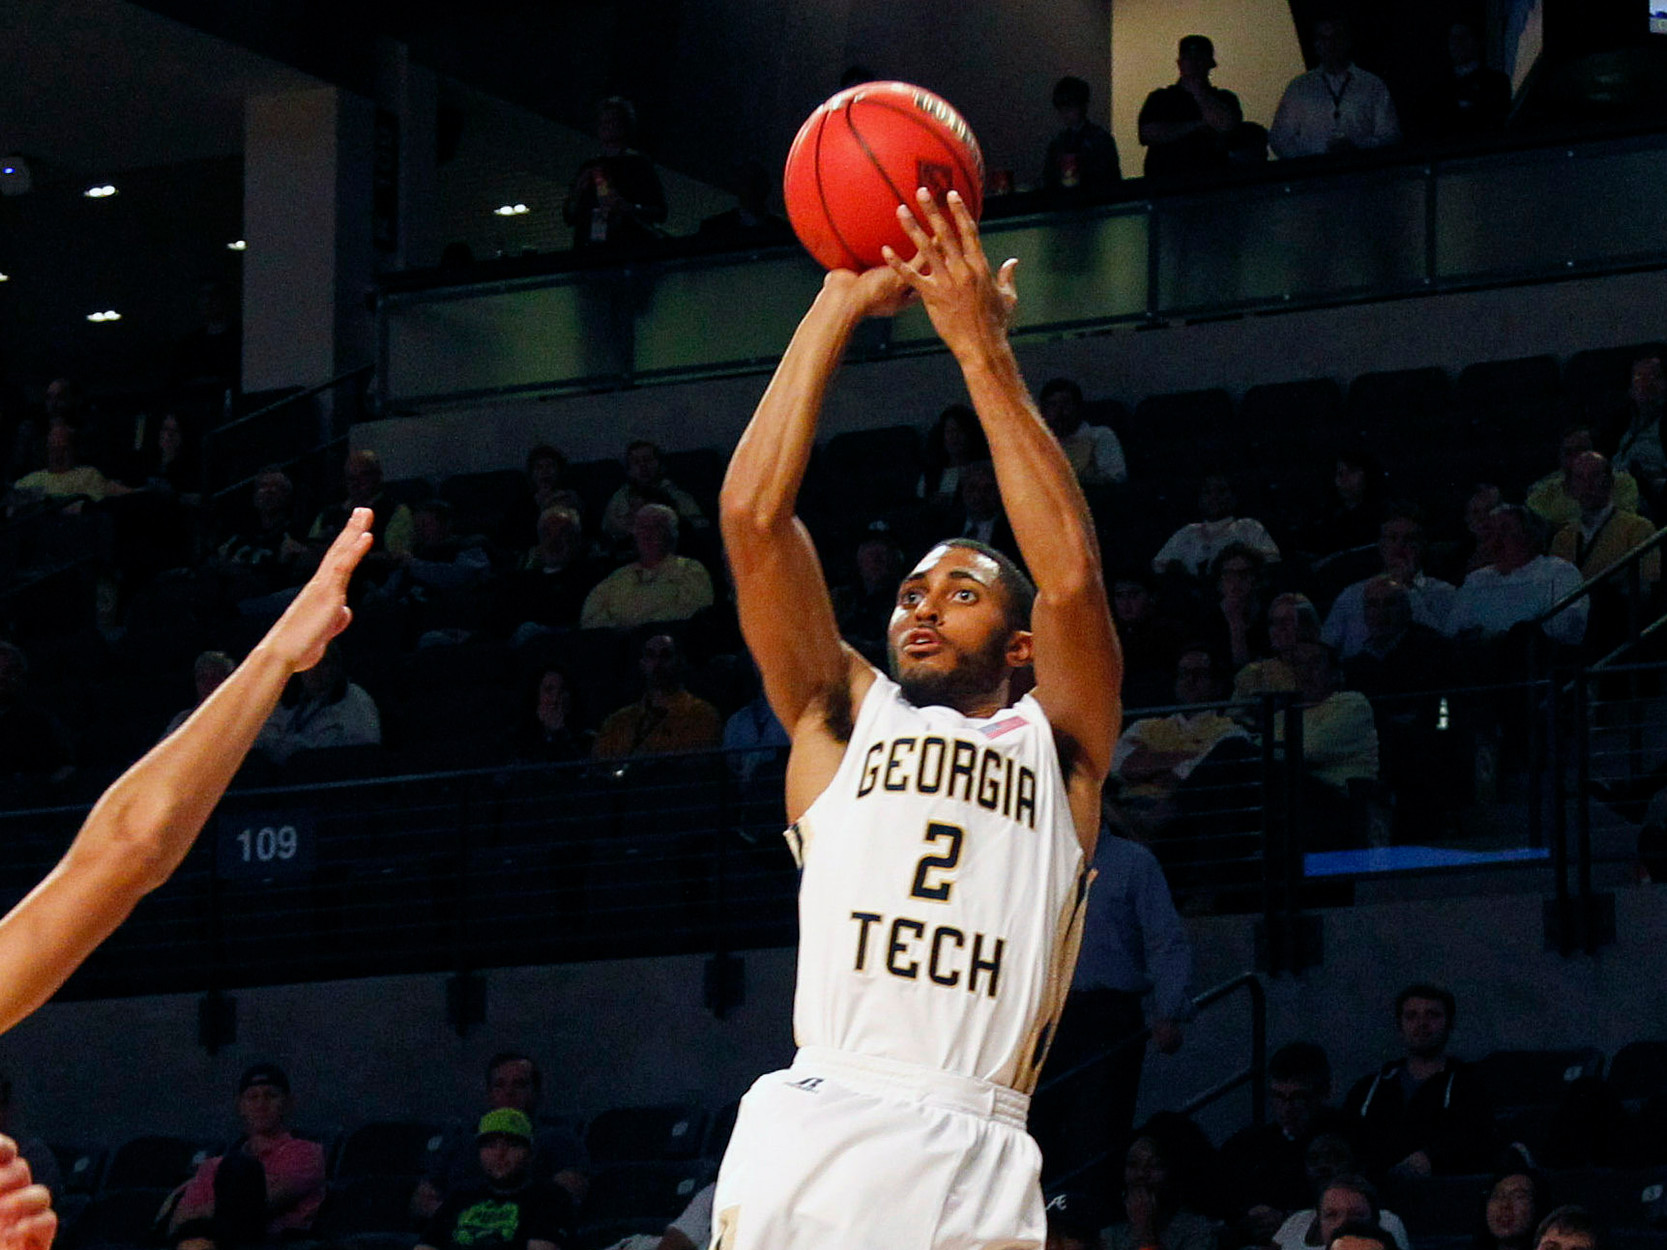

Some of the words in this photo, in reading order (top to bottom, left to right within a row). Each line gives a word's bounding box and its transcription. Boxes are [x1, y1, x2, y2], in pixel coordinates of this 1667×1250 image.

[856, 734, 1037, 830] GEORGIA
[236, 825, 297, 861] 109
[909, 819, 964, 902] 2
[850, 911, 1005, 997] TECH
